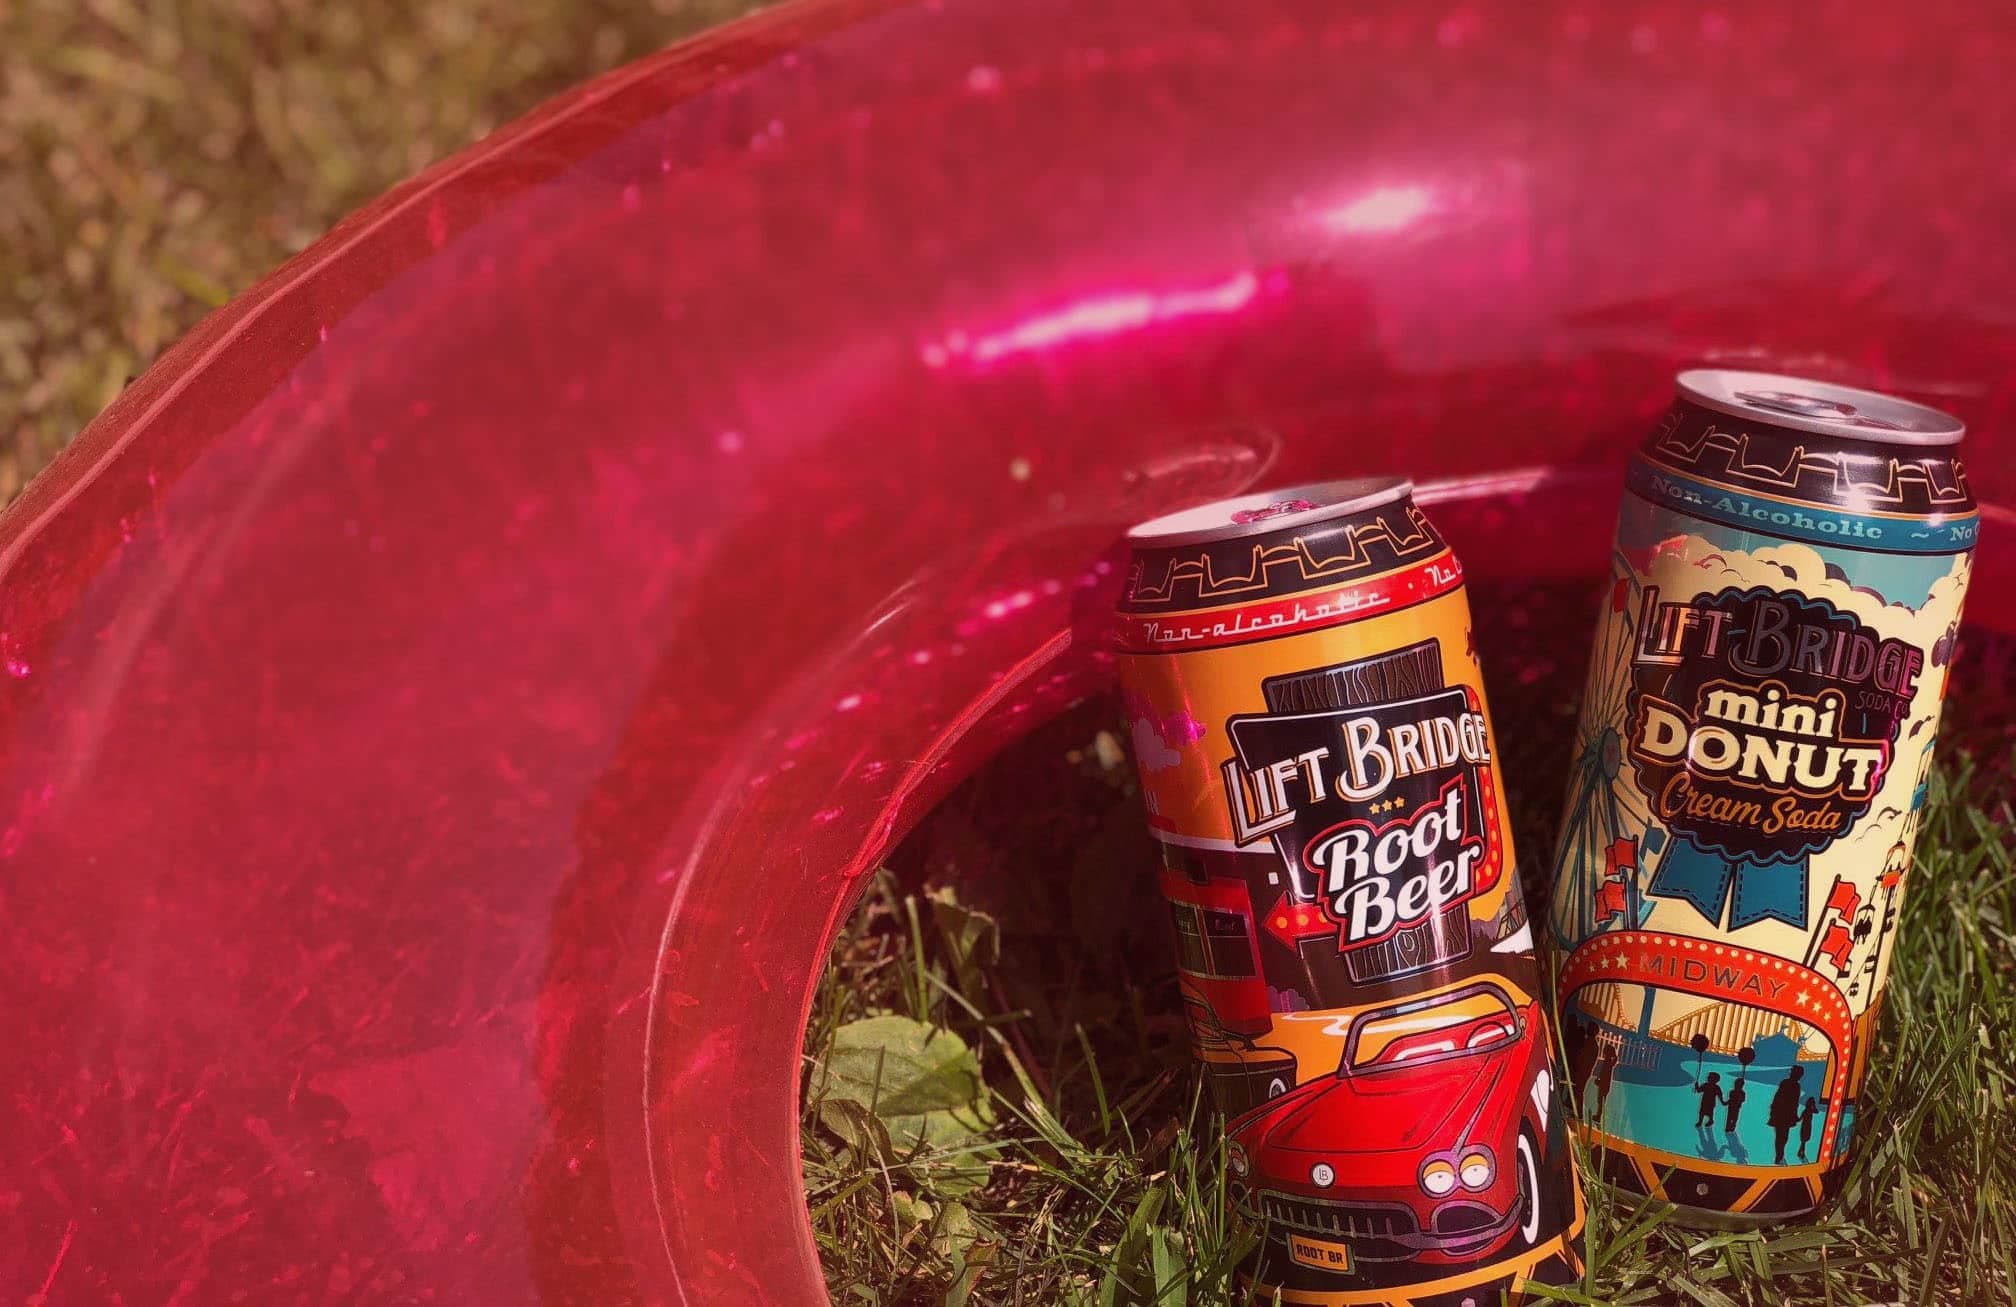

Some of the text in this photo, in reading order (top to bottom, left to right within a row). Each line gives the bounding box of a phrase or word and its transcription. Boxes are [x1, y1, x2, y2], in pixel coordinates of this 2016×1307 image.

[1652, 476, 1972, 541] Non-Alcoholic No
[1143, 589, 1390, 643] Non-alcoholic
[1424, 564, 1456, 587] No
[1635, 586, 1923, 699] LIFT BRIDGE
[1704, 688, 1837, 738] mini
[1854, 690, 1891, 714] SODA
[1222, 713, 1491, 846] LIFT BRIDGE
[1639, 705, 1882, 791] DONUT
[1660, 771, 1842, 834] Cream Soda
[1313, 788, 1463, 892] Root
[1335, 845, 1480, 941] Beer
[1639, 952, 1787, 999] MIDWAY
[1296, 1243, 1344, 1264] ROOT BR
